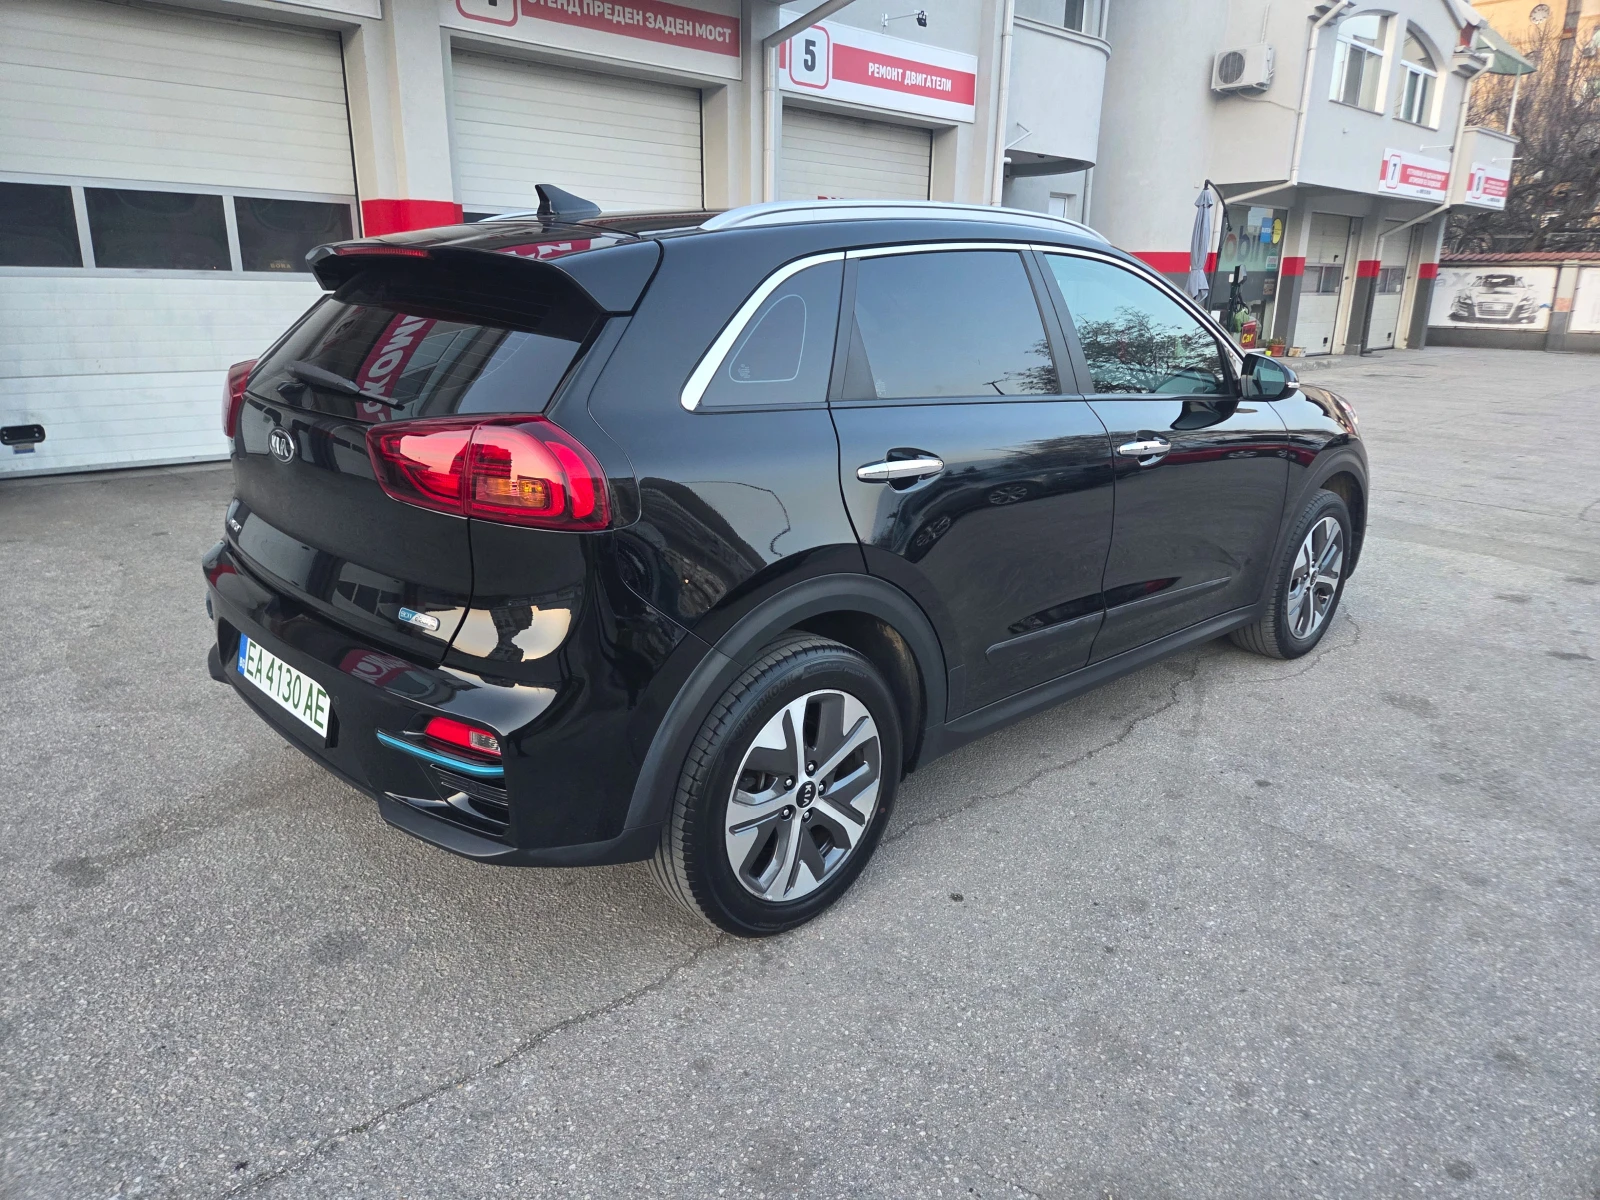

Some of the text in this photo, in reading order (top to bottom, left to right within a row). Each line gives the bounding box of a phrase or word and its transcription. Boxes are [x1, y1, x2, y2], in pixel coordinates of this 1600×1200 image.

[583, 0, 643, 25] ПРЕДЕН
[646, 12, 693, 36] ЗАДЕН
[695, 22, 732, 43] МОСТ
[803, 38, 816, 72] 5
[868, 62, 952, 92] РЕМОНТ ДВИГАТЕЛИ
[1242, 333, 1254, 344] Car
[246, 640, 263, 684] EA
[265, 657, 302, 710] 4130
[303, 682, 327, 729] AE
[802, 784, 812, 806] KIA
